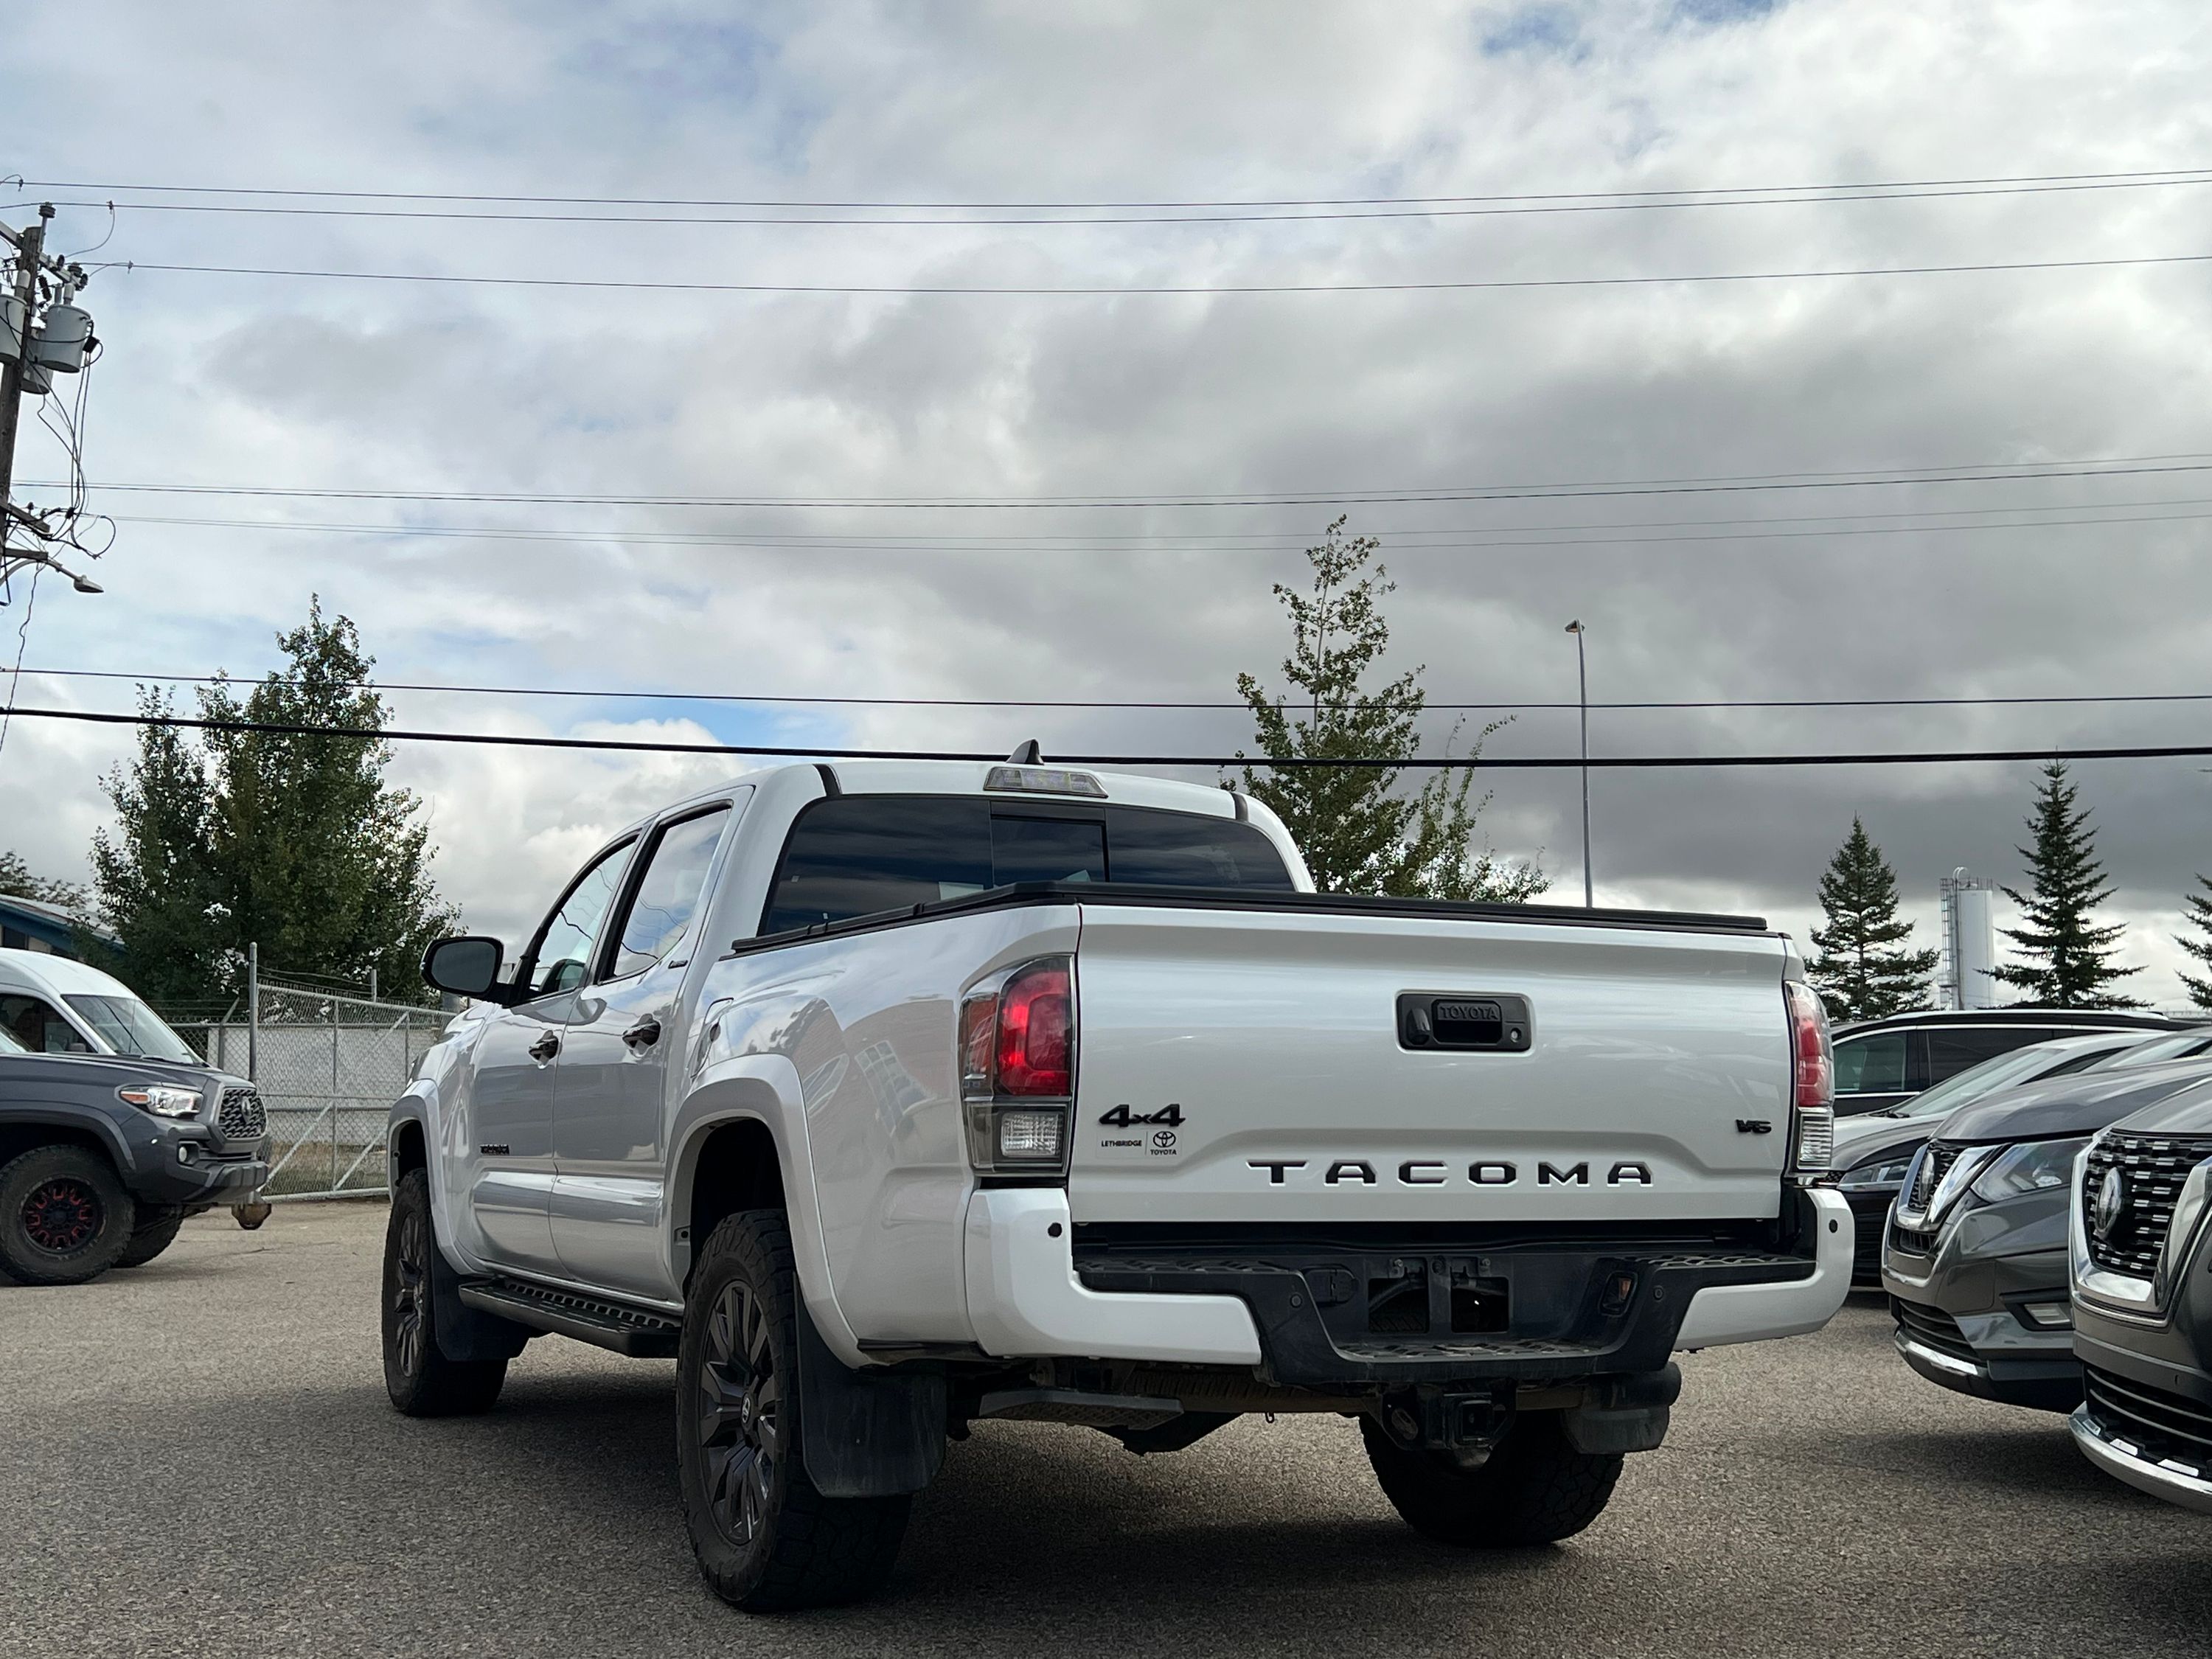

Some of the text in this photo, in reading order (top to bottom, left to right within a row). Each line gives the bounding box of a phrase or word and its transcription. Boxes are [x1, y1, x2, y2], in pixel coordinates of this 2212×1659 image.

[1440, 1006, 1498, 1020] TOYOTA
[1099, 1104, 1186, 1127] 4x4
[1735, 1119, 1772, 1134] V6
[1247, 1160, 1653, 1186] TACOMA
